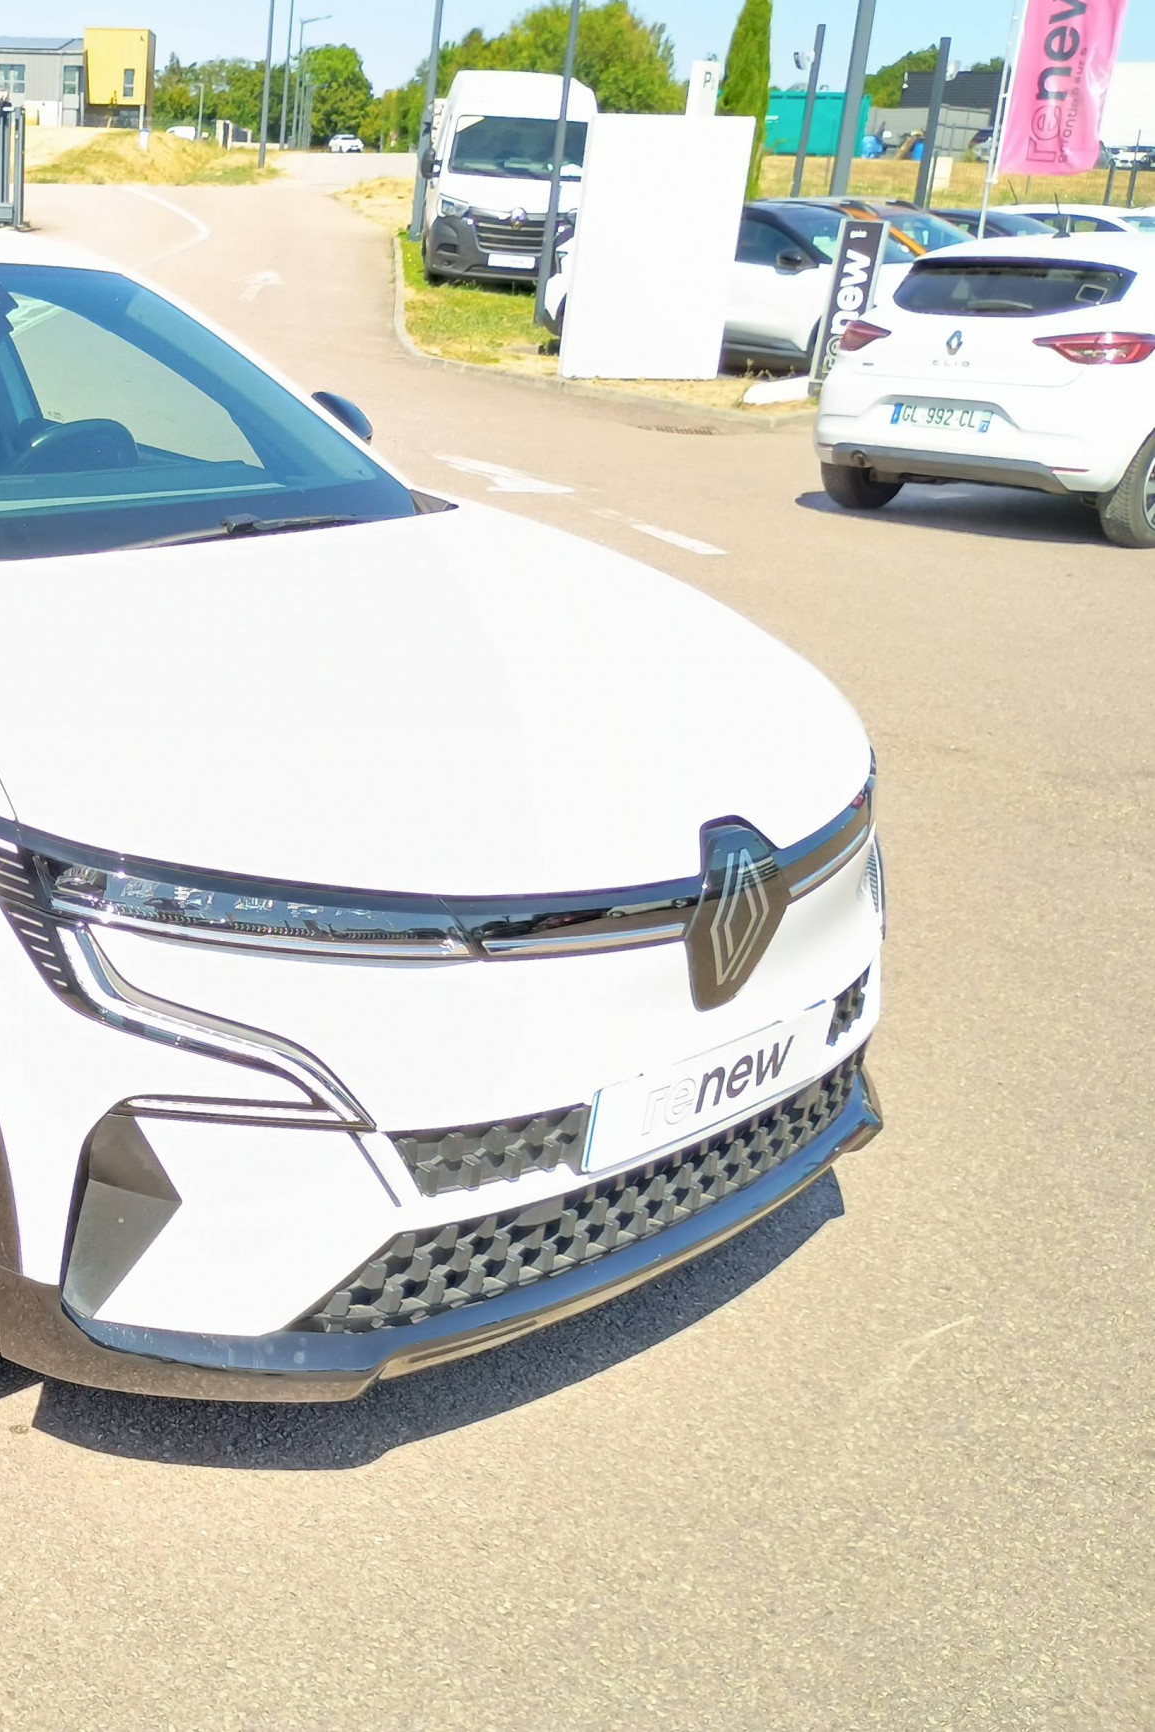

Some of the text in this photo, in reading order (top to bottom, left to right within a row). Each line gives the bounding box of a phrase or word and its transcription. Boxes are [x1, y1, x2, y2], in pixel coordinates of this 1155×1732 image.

[932, 359, 971, 368] CLIO
[902, 405, 918, 423] GL
[926, 407, 954, 426] 992
[958, 410, 975, 428] CL
[642, 1034, 796, 1136] renew
